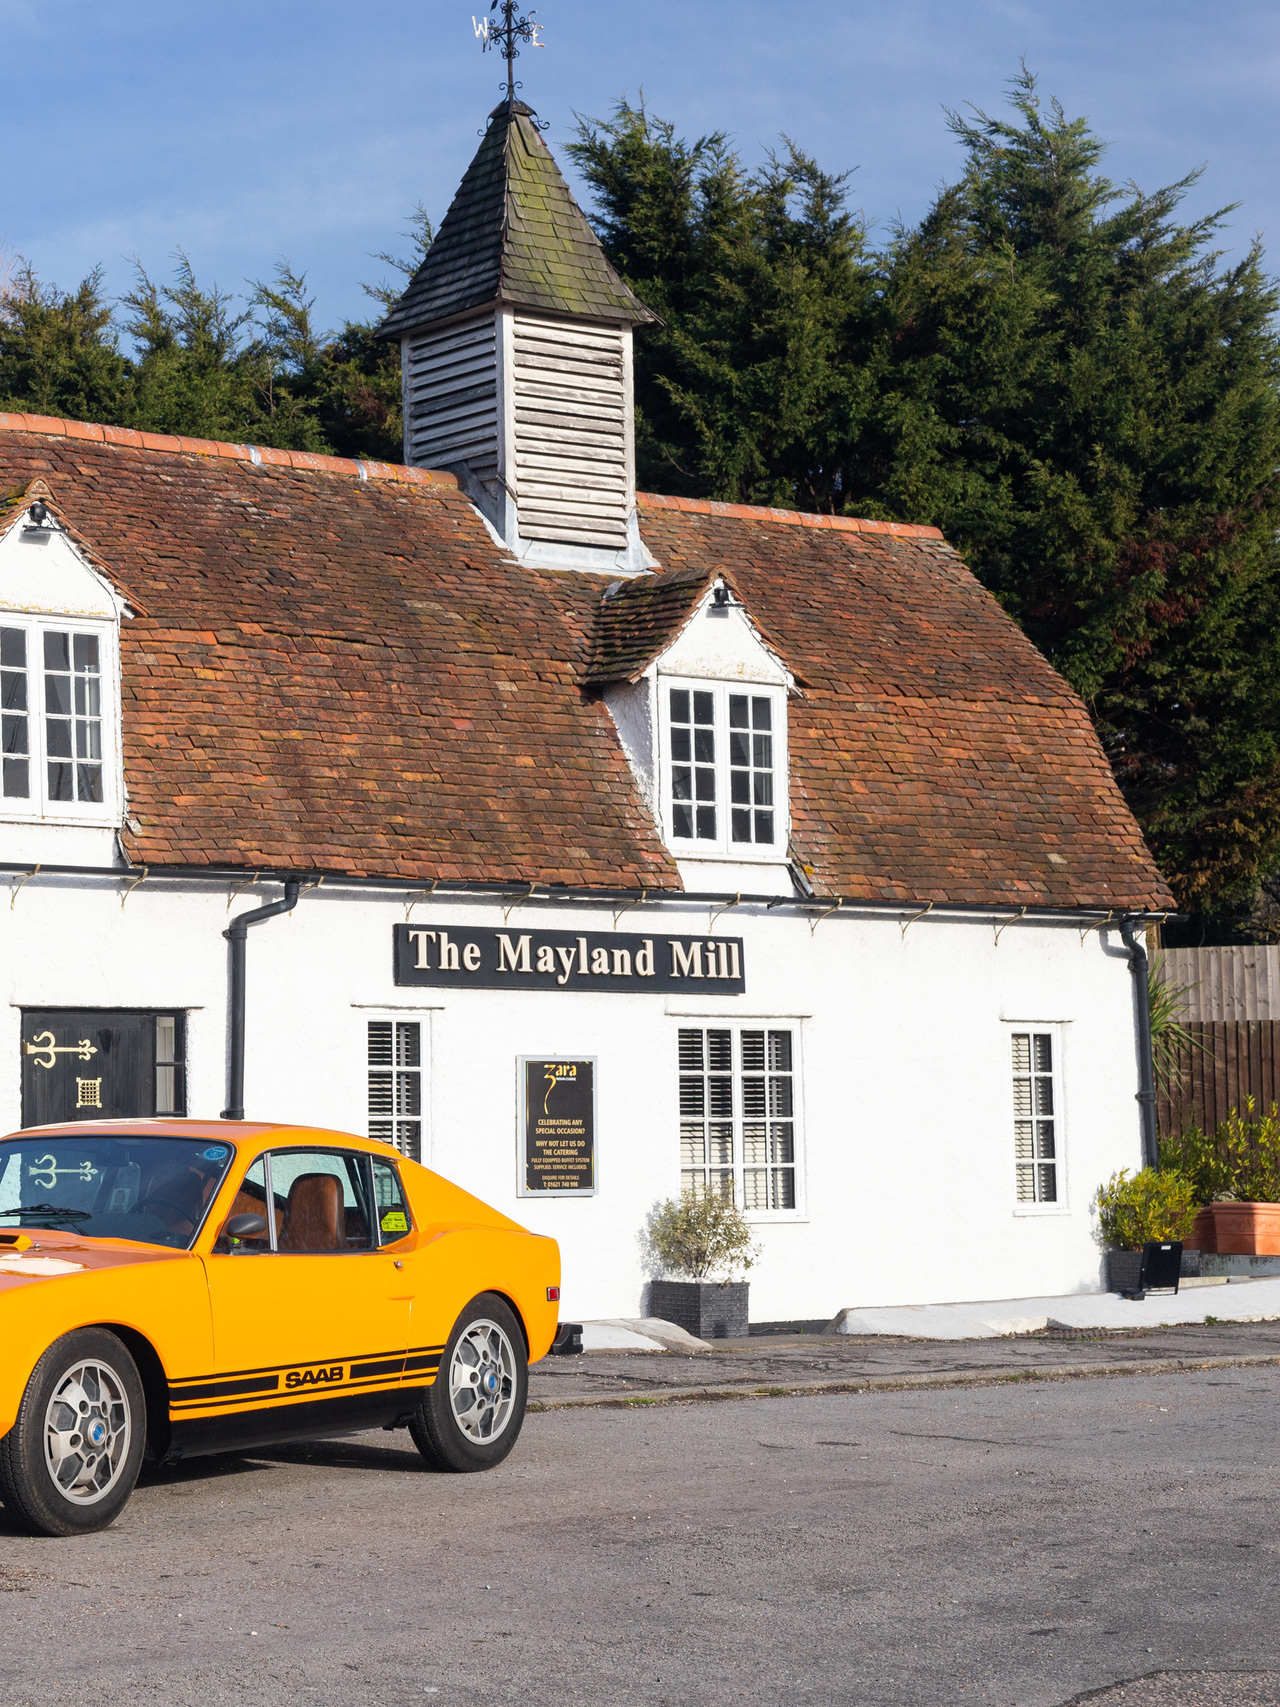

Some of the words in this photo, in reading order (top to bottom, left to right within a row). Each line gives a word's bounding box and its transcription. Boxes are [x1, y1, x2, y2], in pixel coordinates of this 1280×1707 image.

[472, 16, 487, 38] W
[532, 24, 544, 47] E
[408, 930, 481, 971] The
[495, 934, 656, 985] Mayland
[668, 940, 742, 979] Mill
[285, 1366, 343, 1388] SAAB
